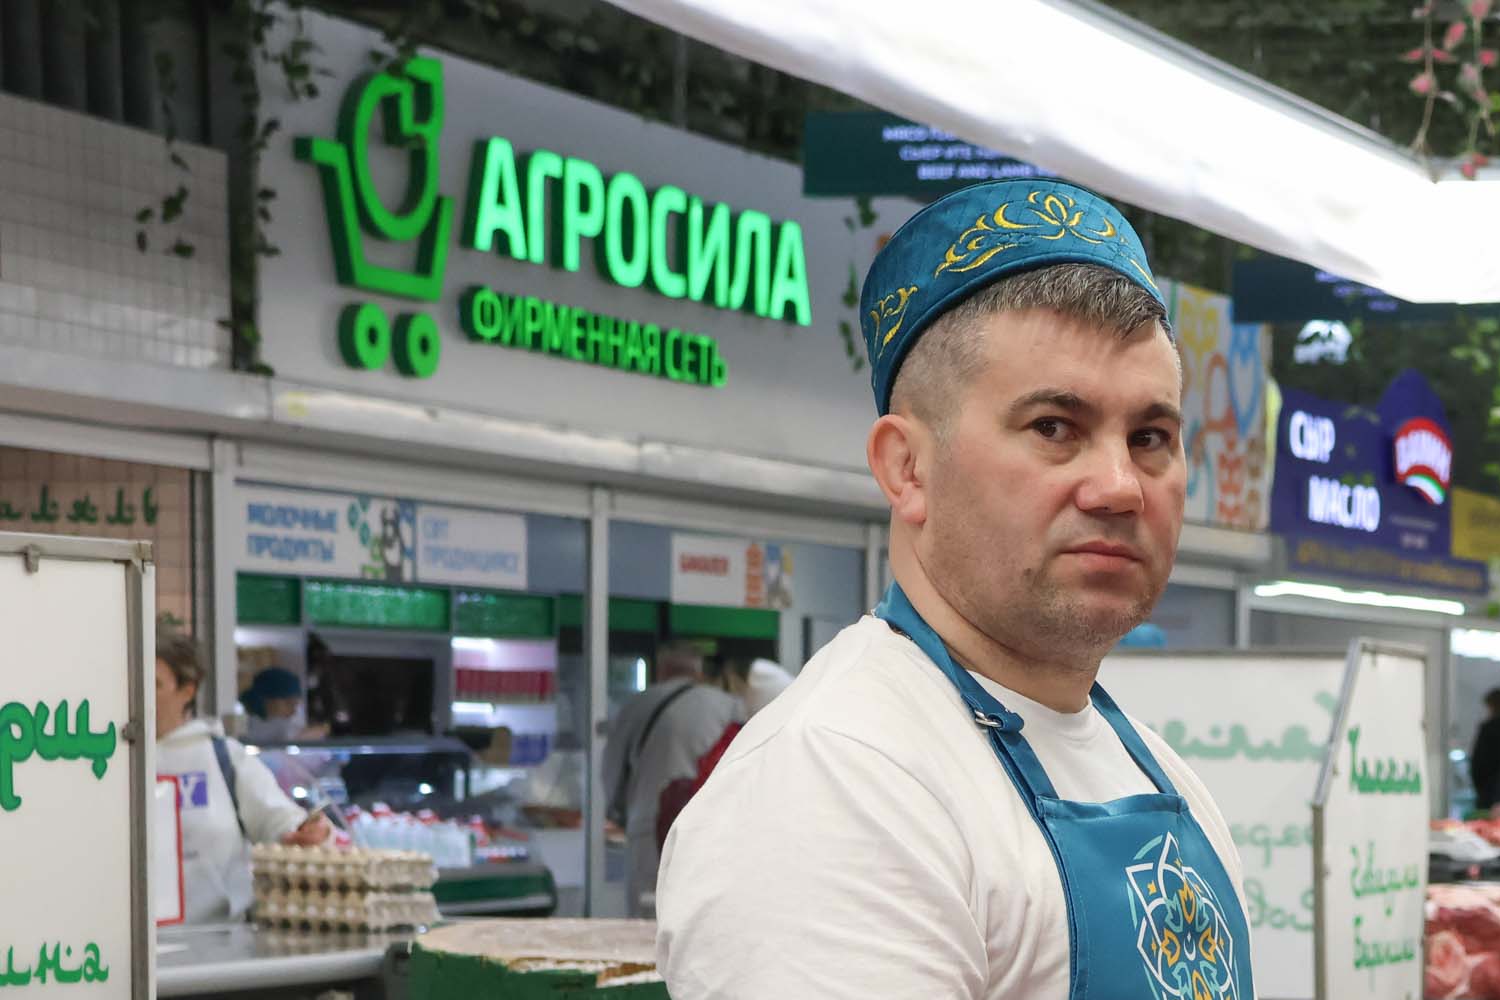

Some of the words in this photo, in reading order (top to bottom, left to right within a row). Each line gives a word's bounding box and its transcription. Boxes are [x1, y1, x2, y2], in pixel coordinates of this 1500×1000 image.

[474, 135, 811, 327] АГРОСИЛА
[473, 285, 661, 375] ФИРМЕННАЯ
[664, 328, 727, 386] СЕТЬ
[1290, 410, 1335, 463] СЫР
[247, 502, 338, 533] МОЛОЧНЫЕ
[1308, 474, 1380, 532] МАСЛО
[247, 533, 335, 562] ПРОДУКТЫ
